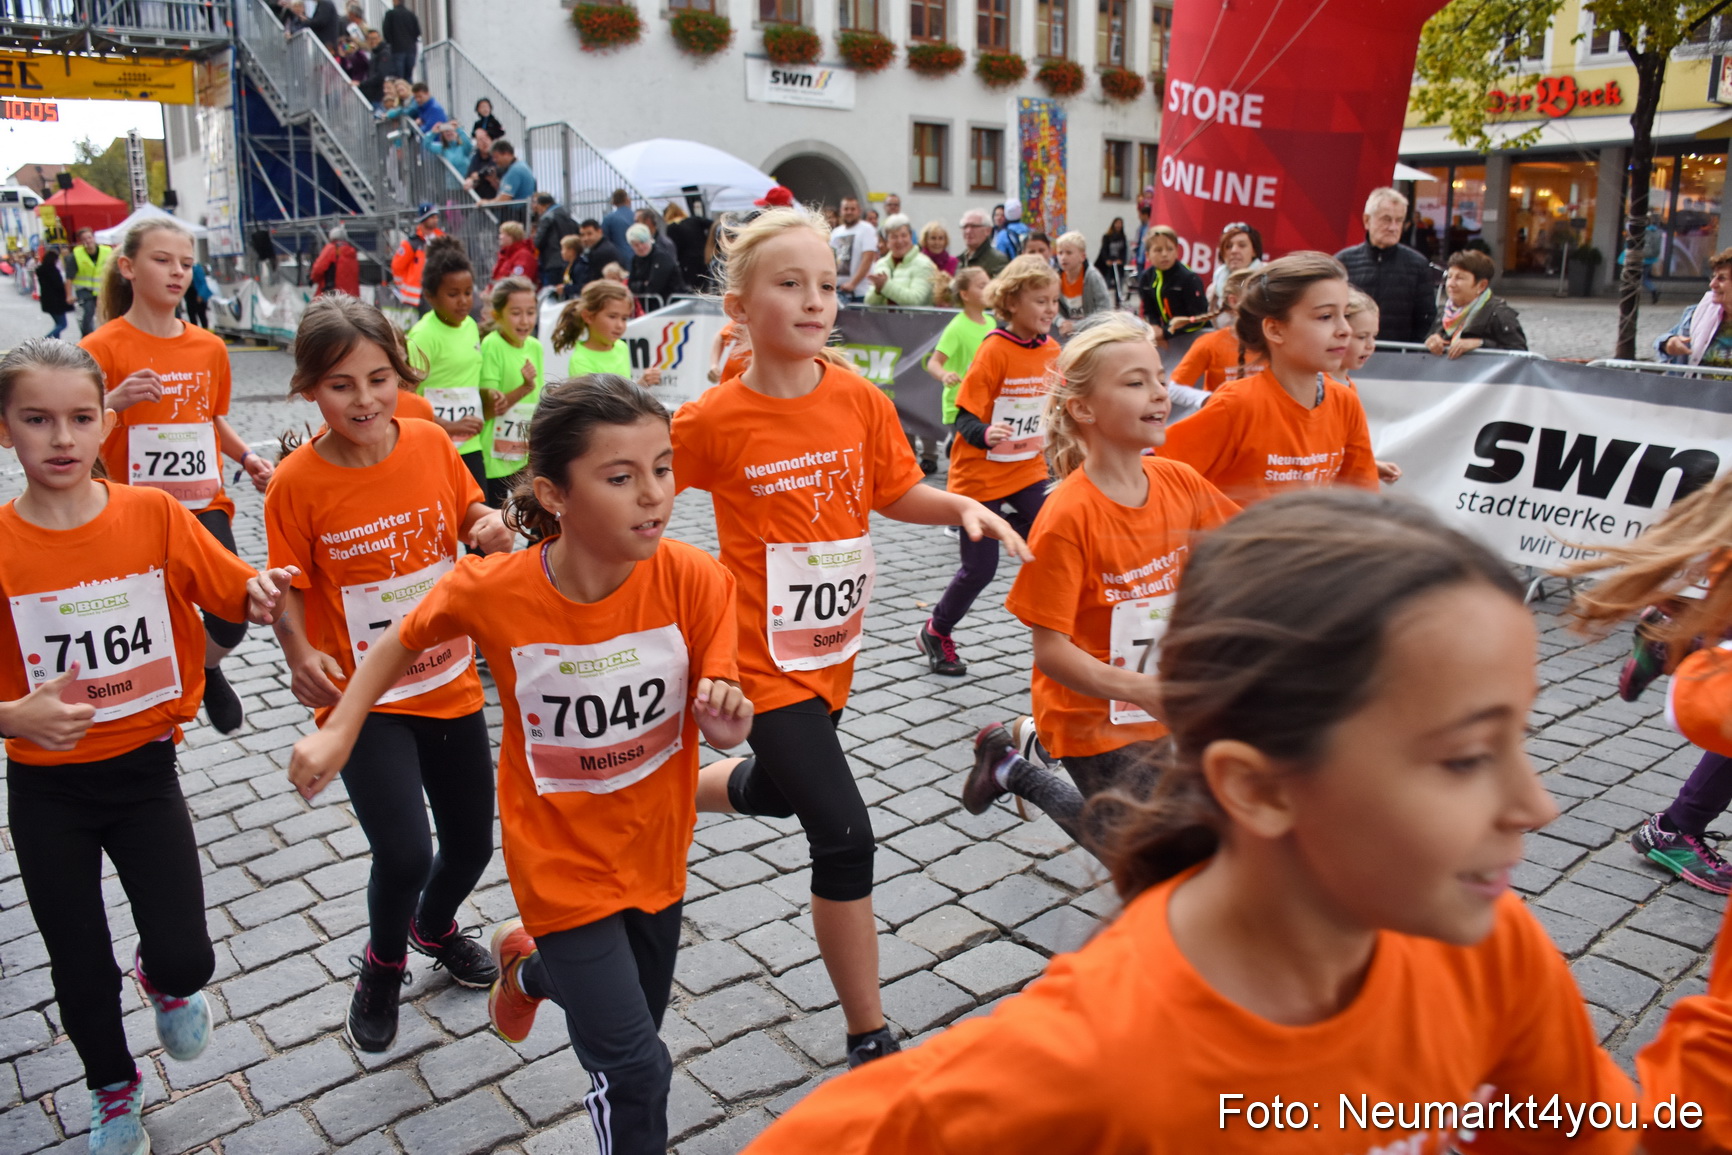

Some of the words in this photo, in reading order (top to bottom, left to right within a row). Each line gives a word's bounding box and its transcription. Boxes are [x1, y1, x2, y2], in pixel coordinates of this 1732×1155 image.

[771, 70, 813, 88] swn
[1168, 79, 1264, 128] STORE
[1486, 89, 1533, 115] Der
[1536, 75, 1624, 118] Beck
[1161, 155, 1278, 209] ONLINE
[160, 371, 193, 382] arkter
[846, 345, 903, 384] CK
[145, 450, 206, 477] 7238
[744, 450, 838, 480] Neumarkter
[1267, 452, 1329, 466] Neumarkter
[1463, 421, 1721, 509] swn
[750, 470, 823, 497] Stadtlauf
[1456, 489, 1616, 534] stadtwerke
[320, 511, 411, 544] Neumarkter
[329, 532, 396, 561] Stadtlauf
[821, 550, 862, 565] BOCK
[1519, 535, 1556, 556] wir
[394, 577, 434, 600] BOCK
[789, 573, 867, 622] 7033
[1104, 573, 1171, 602] Stadtlauf
[75, 592, 129, 613] BOCK
[44, 616, 153, 673] 7164
[33, 669, 46, 678] B5
[577, 648, 639, 674] BOCK
[87, 679, 133, 700] Selma
[542, 678, 666, 739] 7042
[531, 729, 543, 738] B5
[580, 744, 645, 771] Melissa
